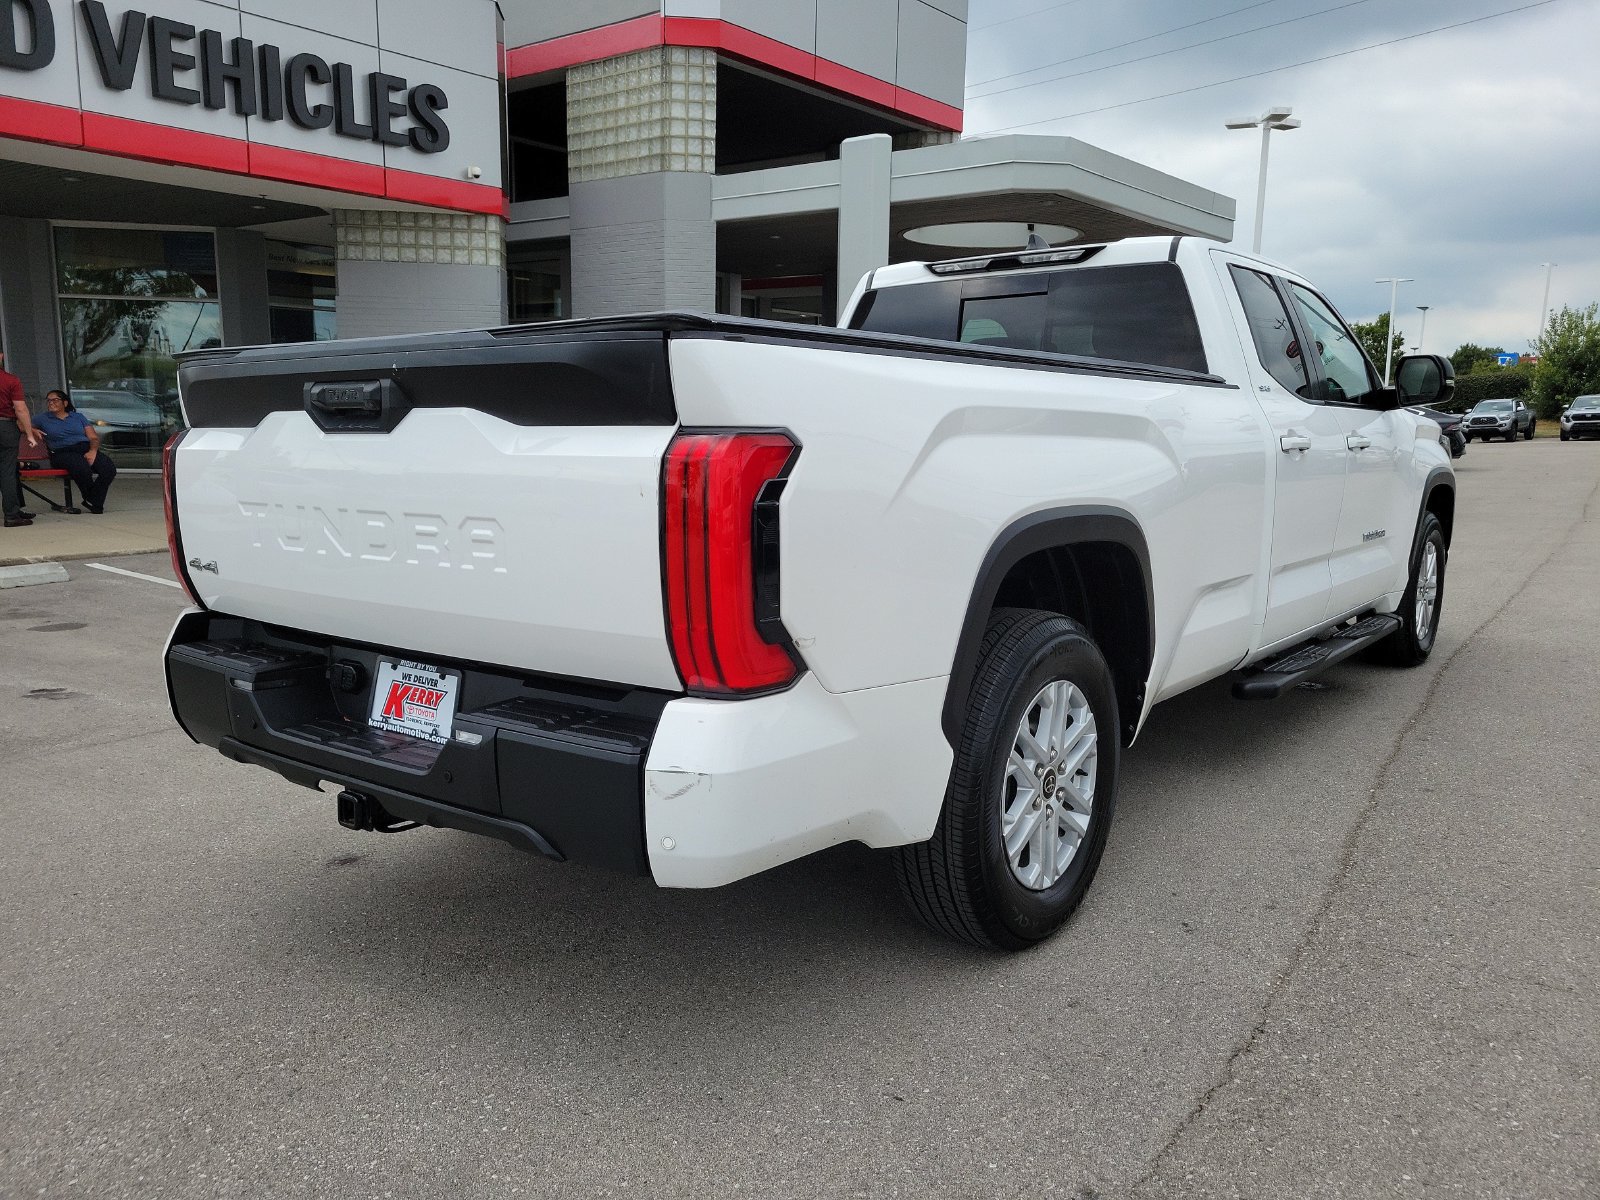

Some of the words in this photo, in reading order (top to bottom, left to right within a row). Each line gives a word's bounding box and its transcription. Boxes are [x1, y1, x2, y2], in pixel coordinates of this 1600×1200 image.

[79, 0, 450, 153] VEHICLES
[238, 500, 508, 574] TUNDRA
[400, 660, 417, 668] RIGHT
[426, 664, 438, 672] YOU
[402, 672, 413, 681] WE
[413, 675, 439, 688] DELIVER
[382, 681, 446, 720] KERRY
[414, 708, 435, 718] TOYOTA
[368, 718, 448, 745] kerryautomotive.com
